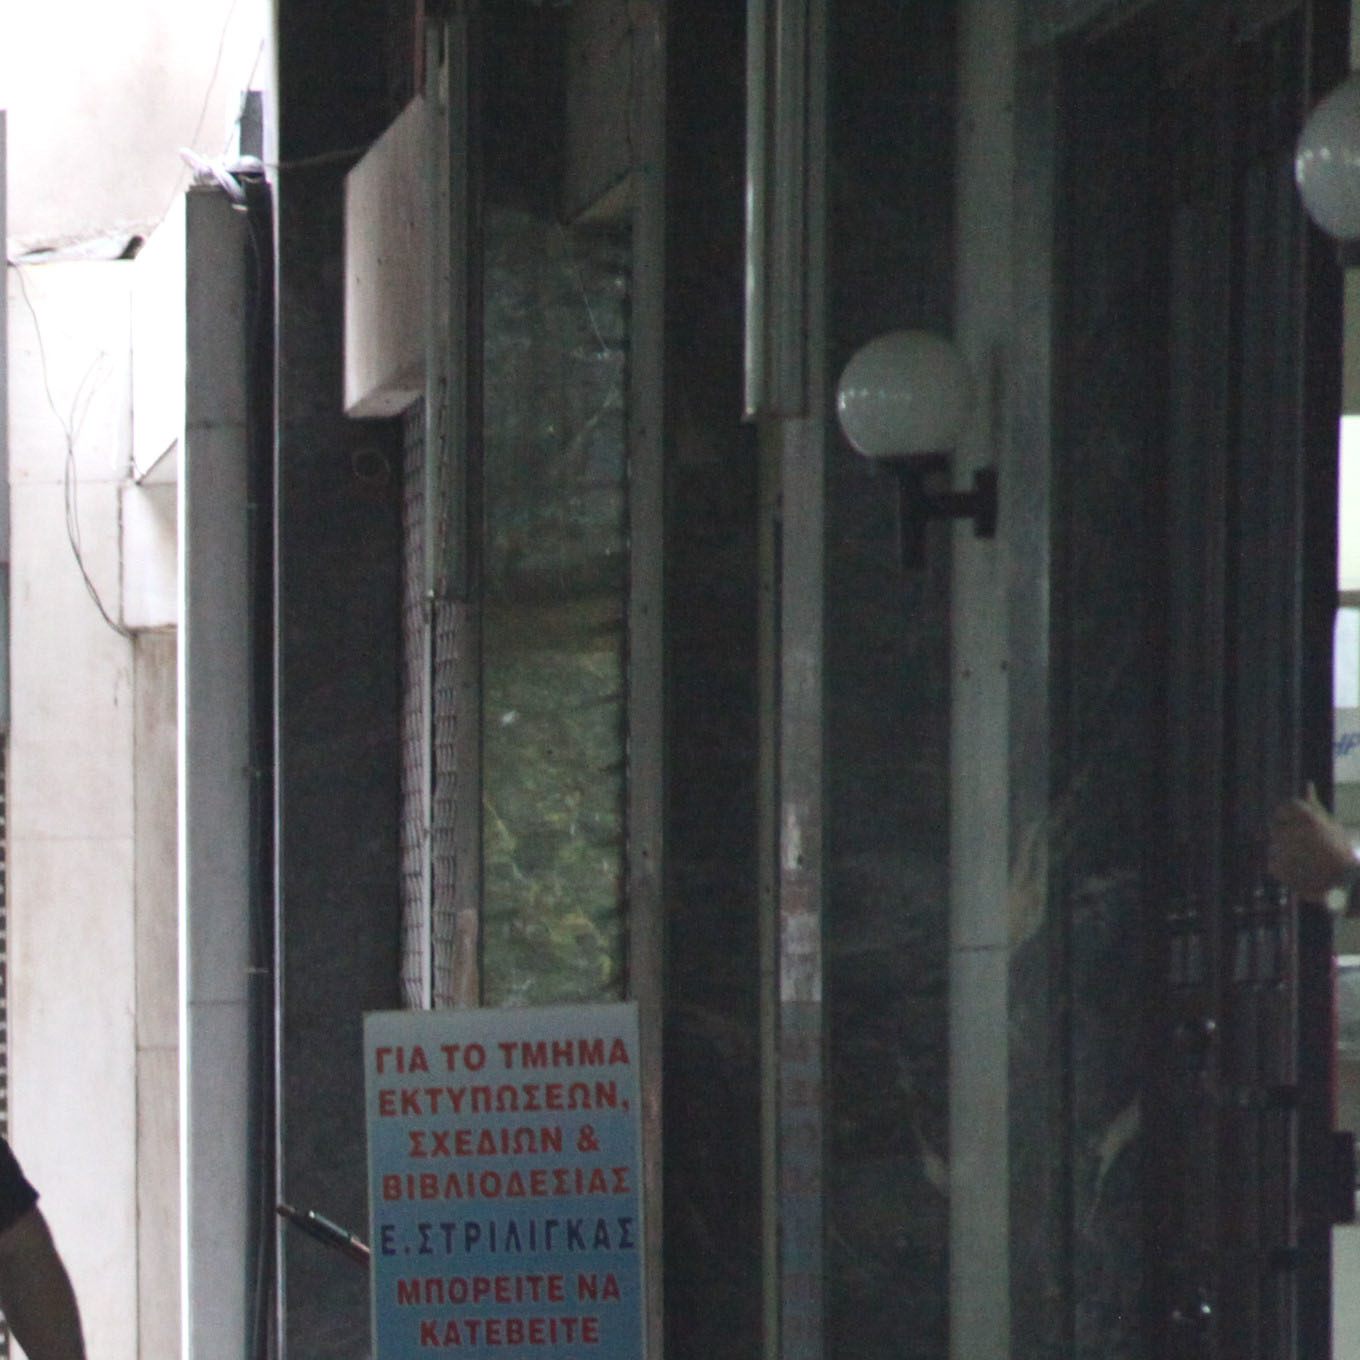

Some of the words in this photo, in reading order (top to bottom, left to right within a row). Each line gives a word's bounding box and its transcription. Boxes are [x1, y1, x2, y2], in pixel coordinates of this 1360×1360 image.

[376, 1046, 429, 1074] ΓΙΑ
[441, 1043, 486, 1072] ΤΟ
[498, 1038, 630, 1069] ΤΜΗΜΑ
[379, 1081, 630, 1117] ΕΚΤΥΠΩΣΕΩΝ,
[409, 1126, 563, 1158] ΣΧΕΔΙΩΝ
[577, 1124, 600, 1152] &
[382, 1166, 631, 1201] ΒΙΒΛΙΟΔΕΣΙΑΣ
[397, 1275, 565, 1305] ΜΠΟΡΕΙΤΕ
[578, 1273, 621, 1300] ΝΑ
[420, 1317, 600, 1347] ΚΑΤΕΒΕΙΤΕ
